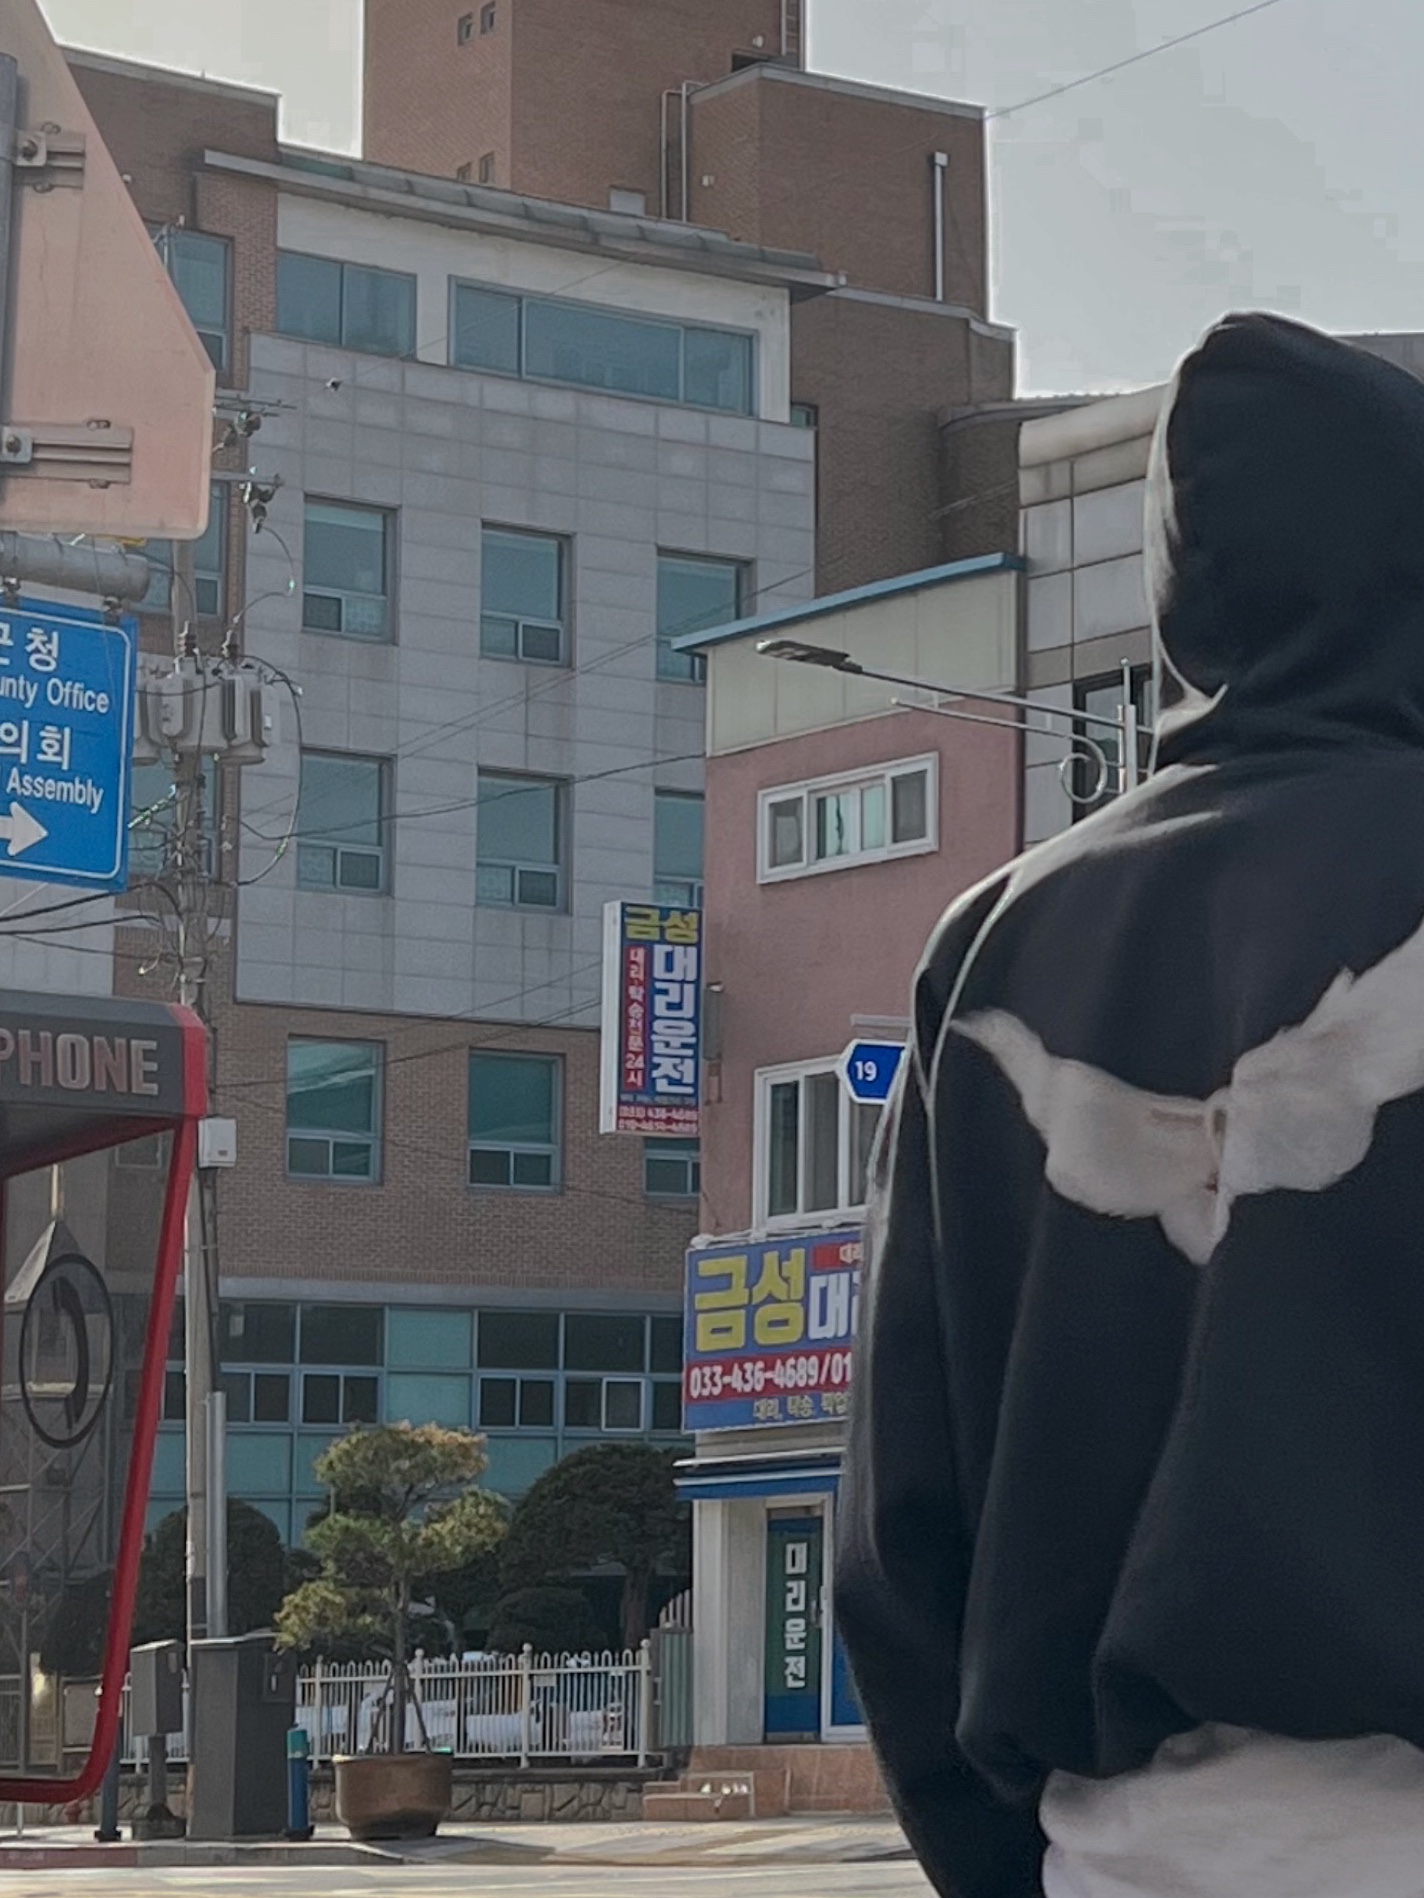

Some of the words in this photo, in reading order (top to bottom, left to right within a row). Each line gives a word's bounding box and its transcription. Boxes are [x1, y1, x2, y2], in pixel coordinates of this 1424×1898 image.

[46, 676, 111, 714] Office
[6, 766, 104, 815] Assembly
[624, 907, 699, 944] 금성
[650, 944, 699, 1095] 대리운전
[855, 1061, 877, 1081] 19
[695, 1248, 806, 1352] 금성
